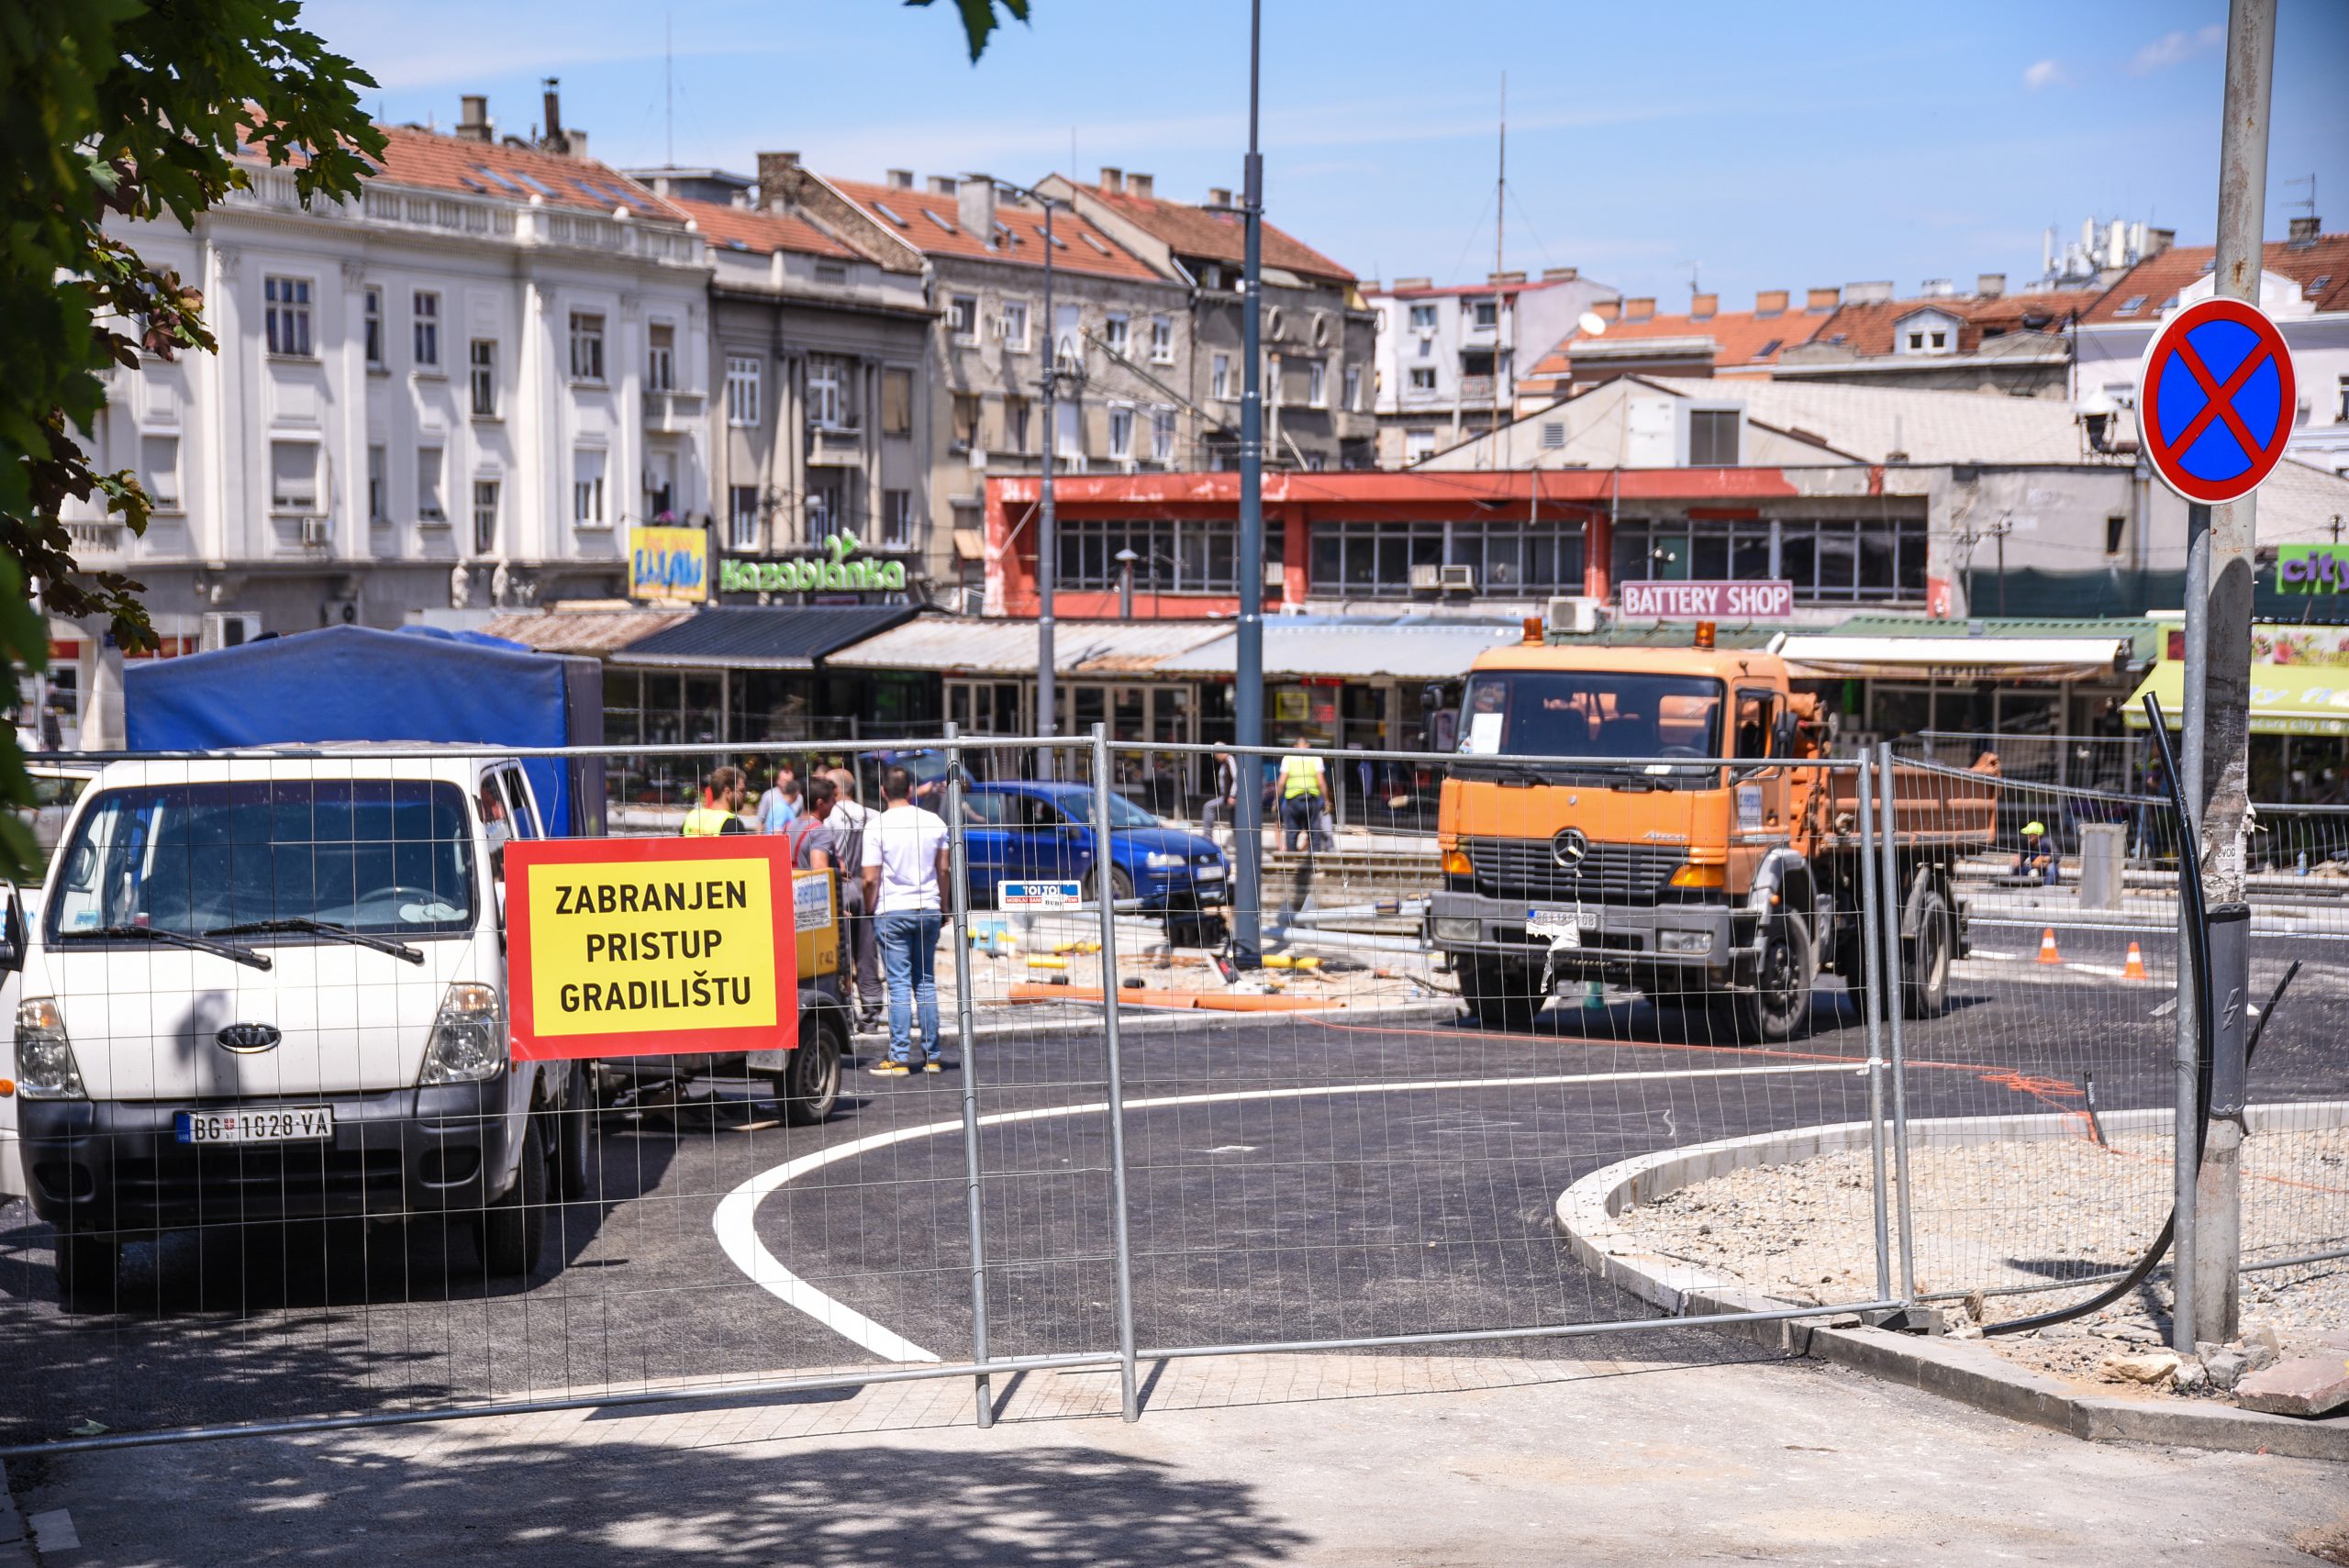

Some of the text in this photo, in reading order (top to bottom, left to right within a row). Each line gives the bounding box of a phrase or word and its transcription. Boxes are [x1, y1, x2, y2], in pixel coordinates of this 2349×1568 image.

[720, 557, 907, 592] Kazablanka
[2282, 550, 2349, 592] city
[1625, 586, 1789, 615] BATTERY SHOP
[555, 879, 748, 915] ZABRANJEN
[1023, 885, 1041, 895] TOI
[586, 929, 722, 962] PRISTUP
[560, 970, 751, 1013] GRADILIŠTU
[227, 1027, 272, 1045] KIA
[195, 1117, 221, 1140] BG
